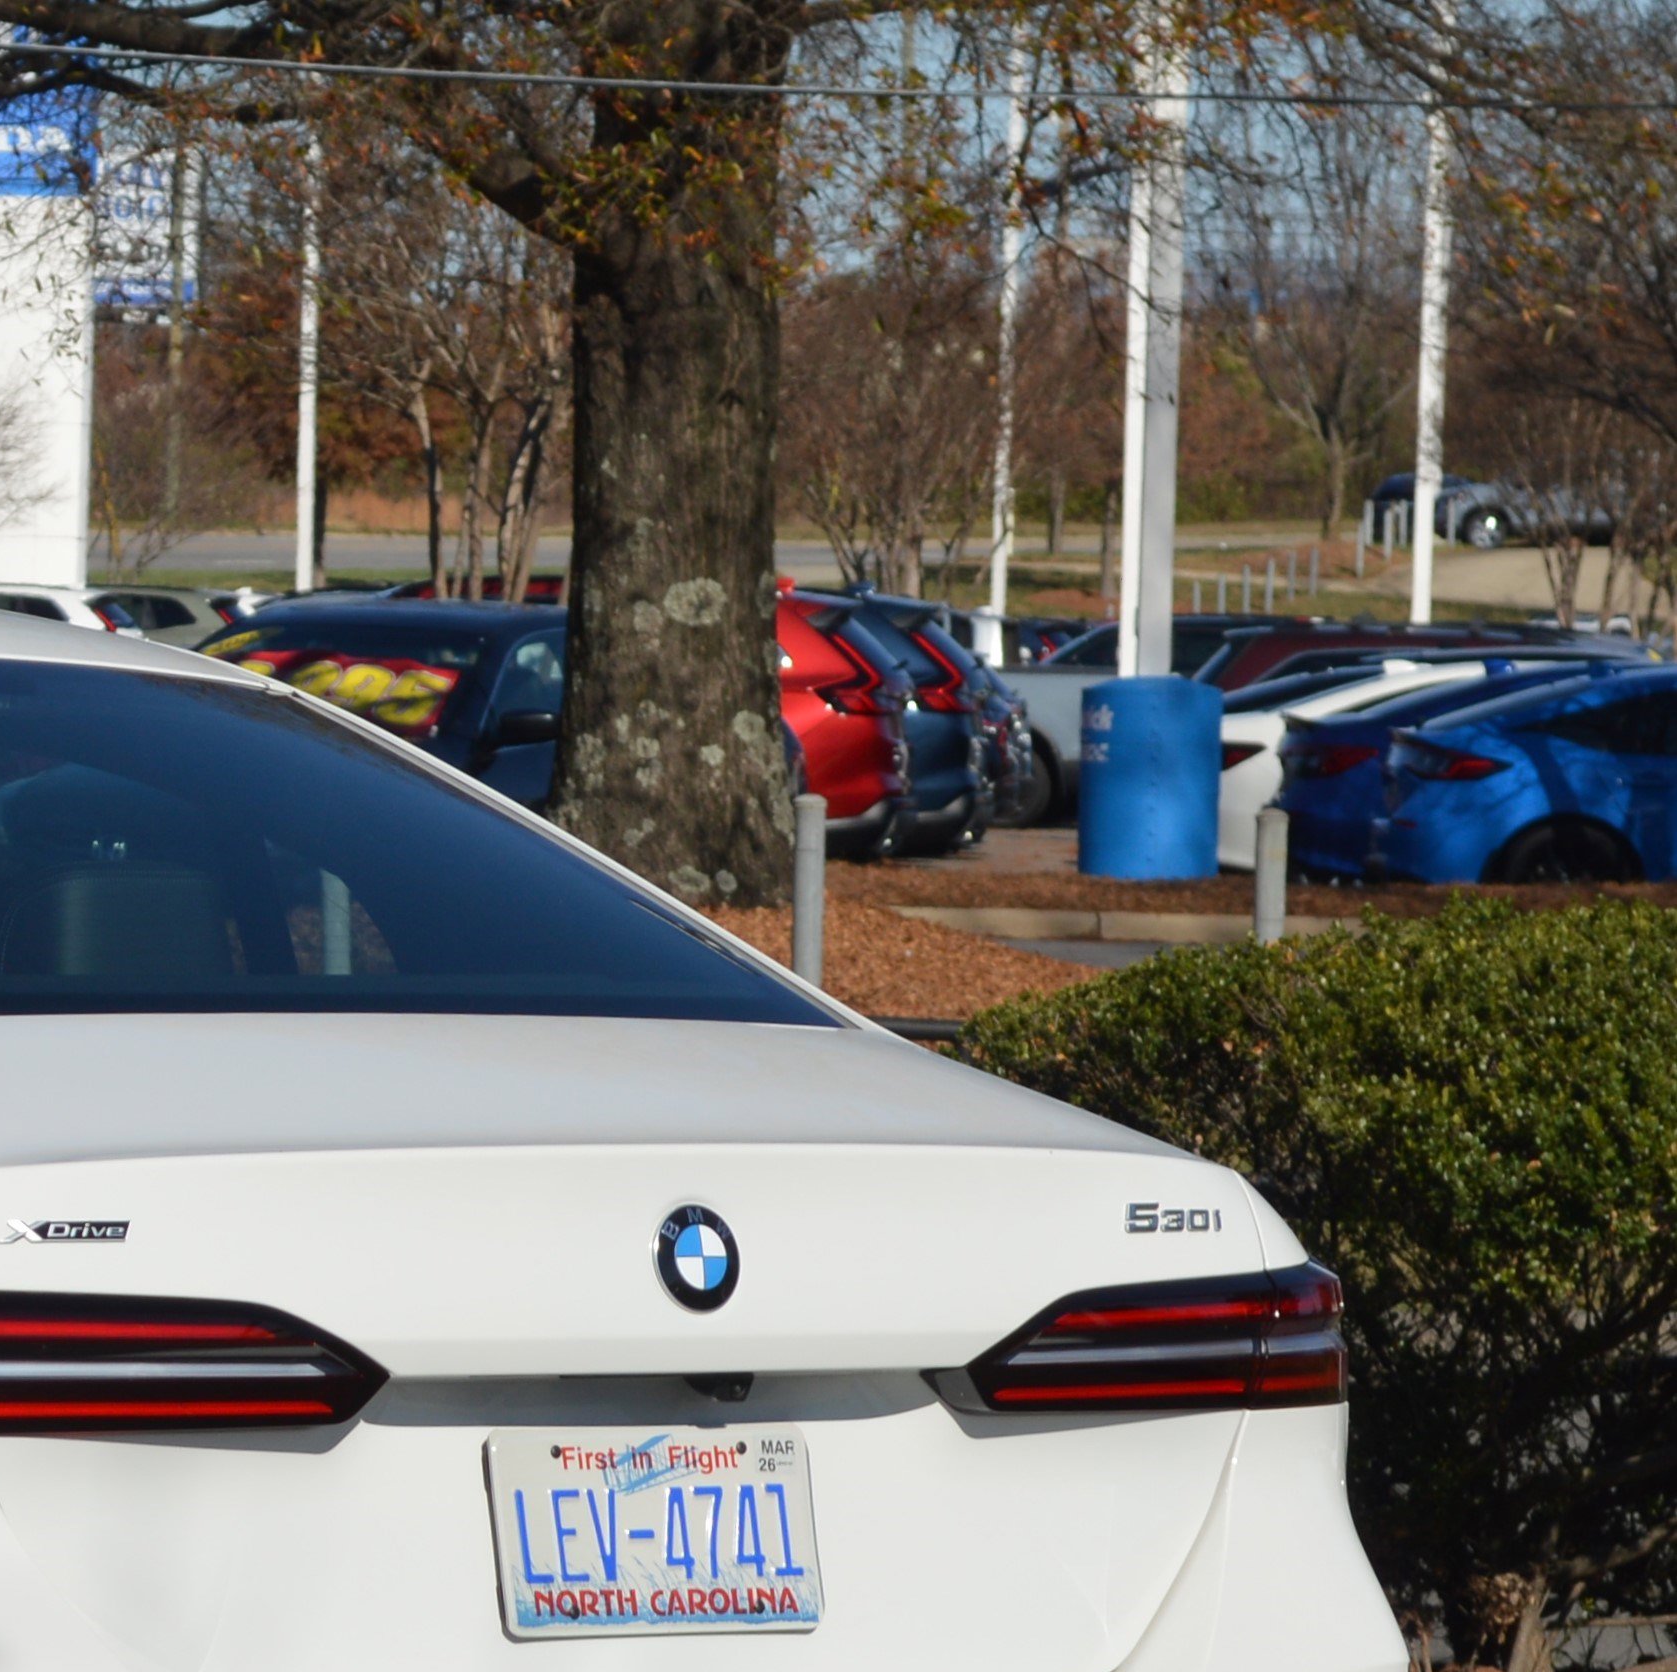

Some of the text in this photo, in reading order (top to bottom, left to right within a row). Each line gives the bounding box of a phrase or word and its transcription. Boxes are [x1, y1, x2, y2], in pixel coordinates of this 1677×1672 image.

[661, 1207, 732, 1240] BMW
[560, 1444, 739, 1475] First in Flight
[761, 1439, 795, 1457] MAR
[758, 1457, 778, 1474] 26
[514, 1483, 804, 1584] LEV-4741
[535, 1588, 799, 1617] NORTH CAROLINA
